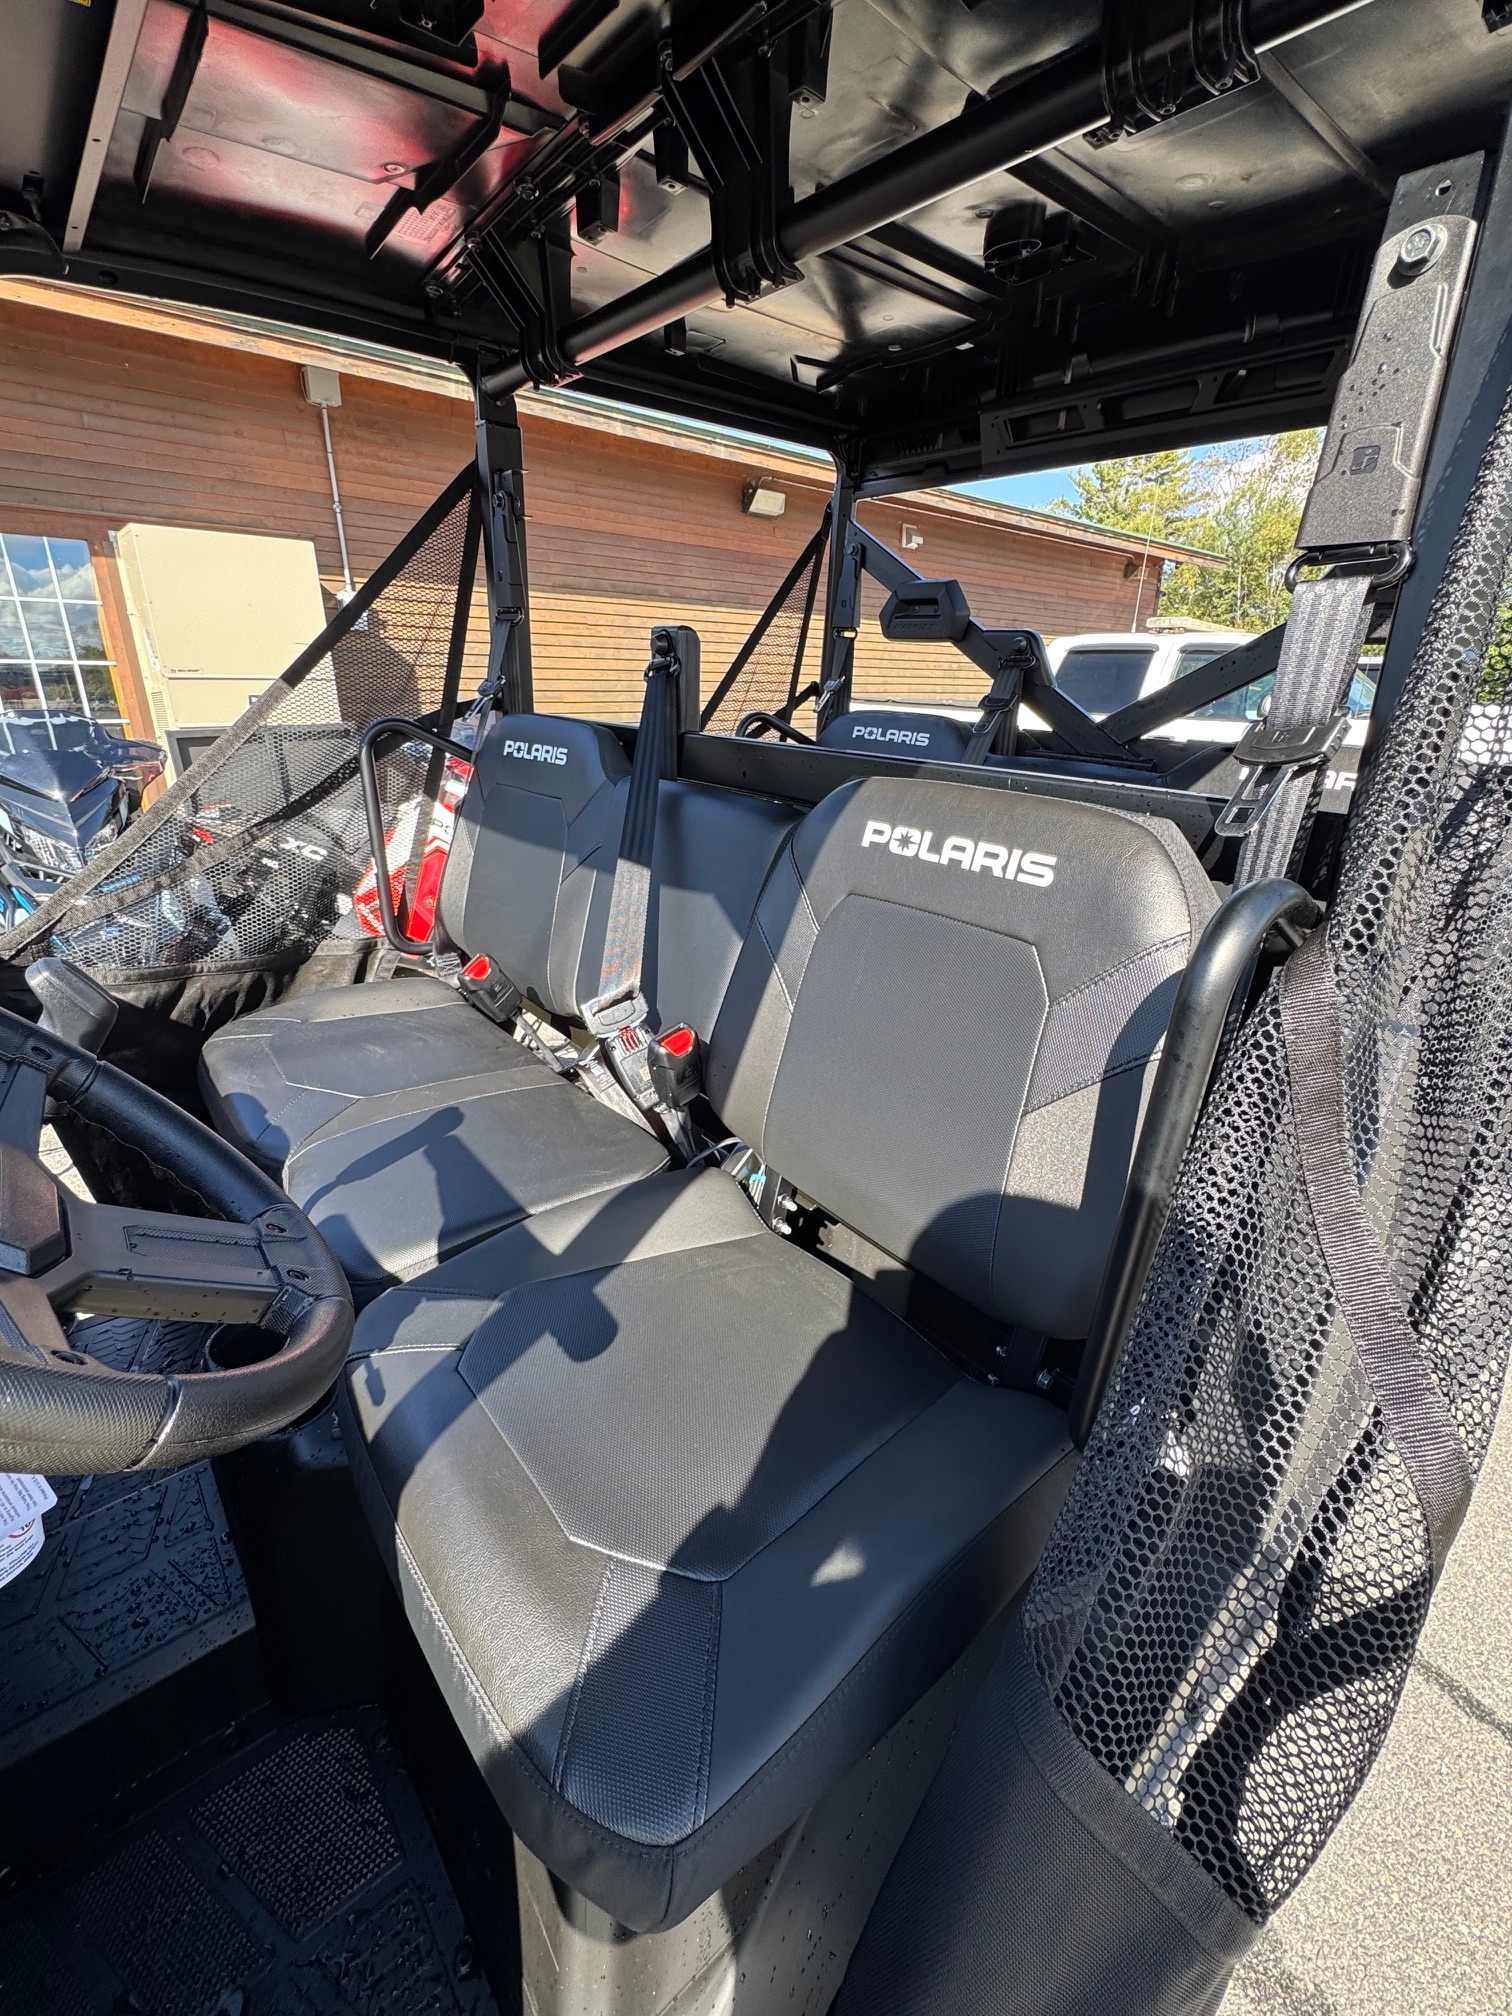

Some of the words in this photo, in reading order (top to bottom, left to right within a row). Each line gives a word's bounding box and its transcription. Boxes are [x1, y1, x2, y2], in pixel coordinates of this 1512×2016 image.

[852, 726, 930, 746] POLARIS
[503, 740, 568, 766] POLARIS
[861, 820, 1057, 888] POLARIS
